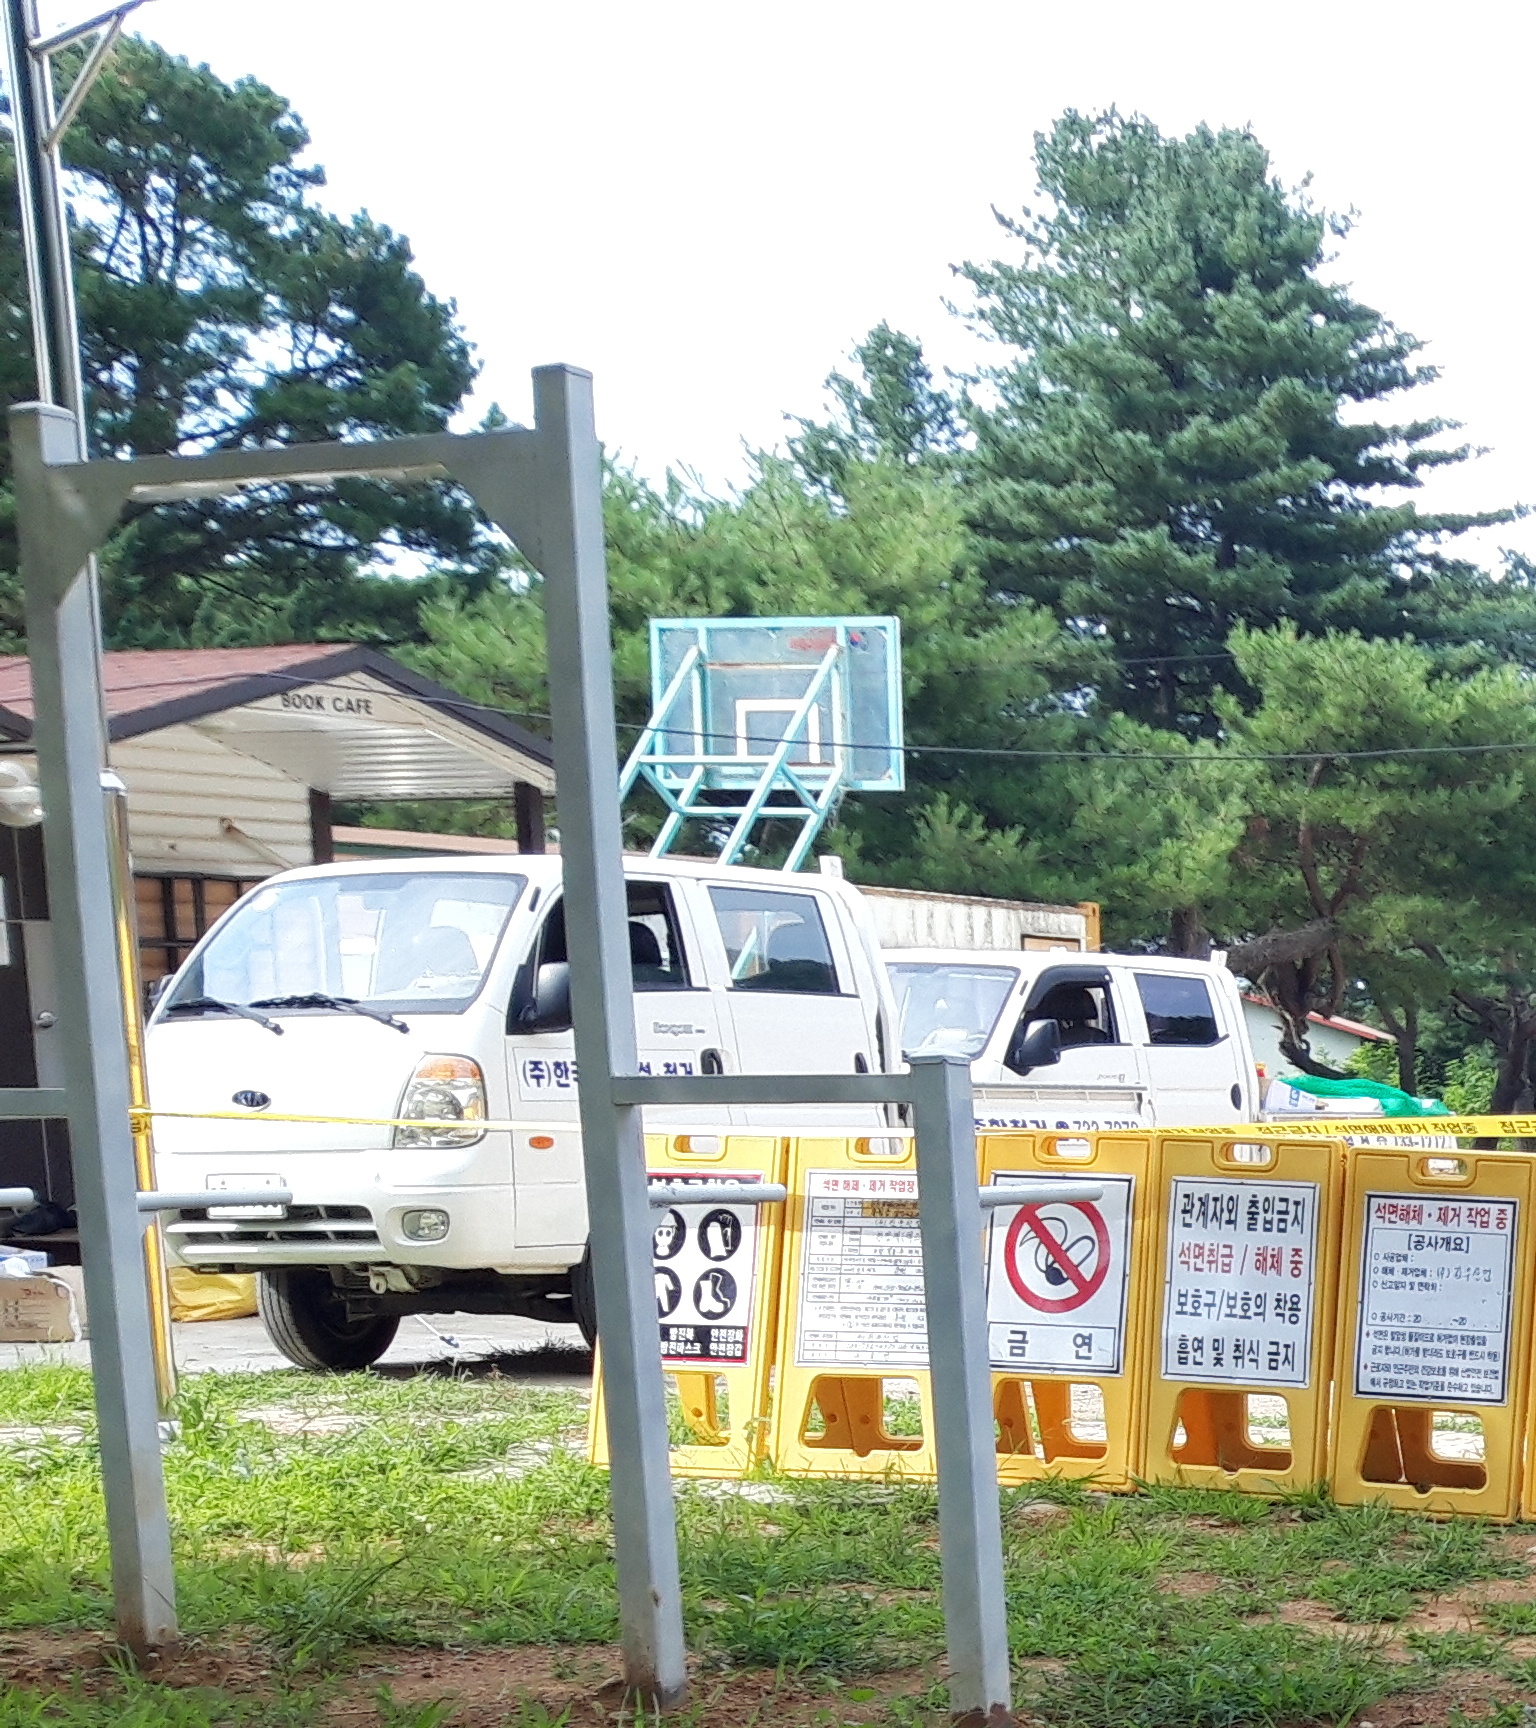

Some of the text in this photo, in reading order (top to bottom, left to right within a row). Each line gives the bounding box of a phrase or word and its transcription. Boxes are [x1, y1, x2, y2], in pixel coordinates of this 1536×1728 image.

[281, 692, 373, 715] BOOK CAFE
[1180, 1191, 1306, 1235] 관계자외 출입금지
[1466, 1206, 1491, 1229] 작업
[1496, 1208, 1509, 1231] 중
[1178, 1241, 1235, 1274] 석면취급
[1254, 1245, 1283, 1278] 해체
[1289, 1247, 1304, 1279] 중
[1407, 1233, 1471, 1255] [공사개요]
[1175, 1288, 1302, 1326] 보호구/보호의 착용
[1176, 1333, 1296, 1373] 흡연 및 취식 금지
